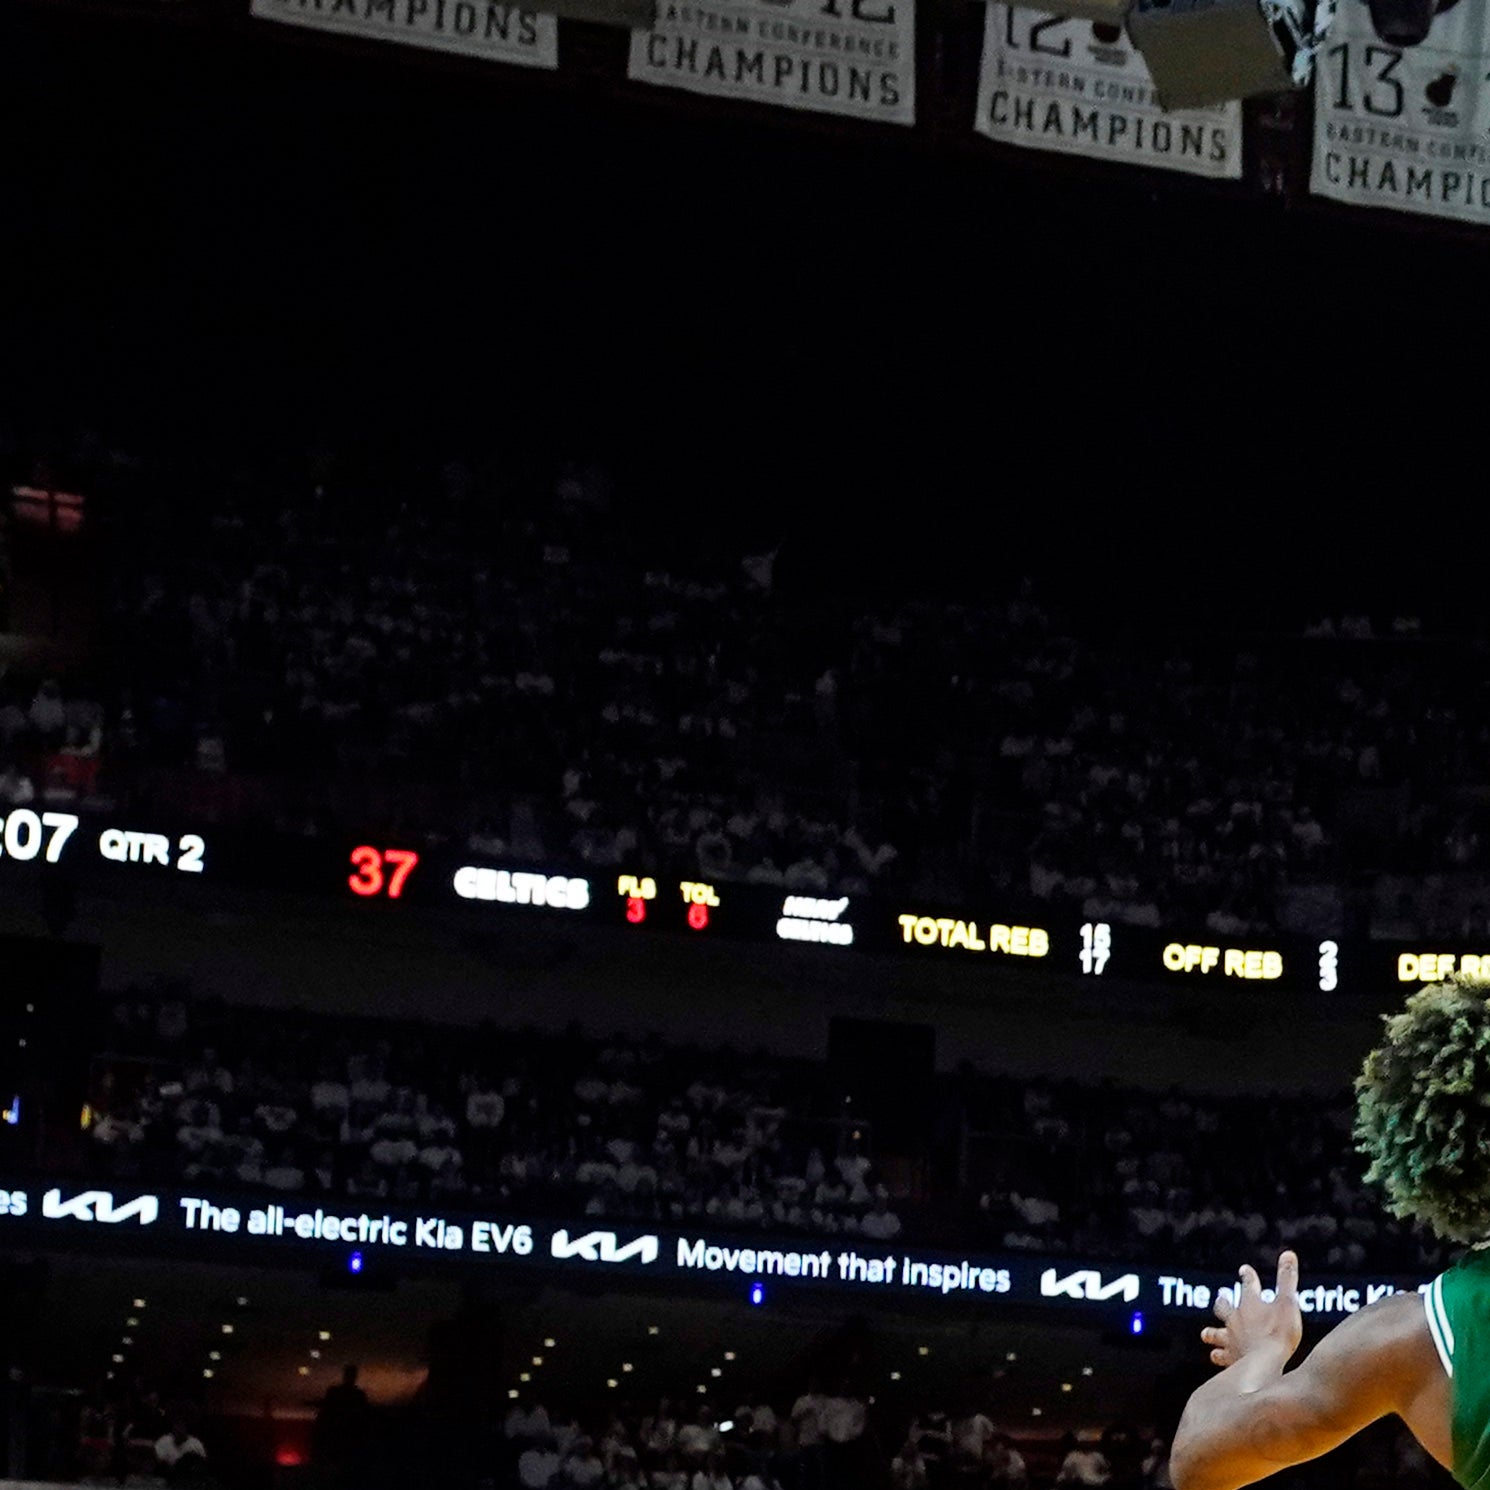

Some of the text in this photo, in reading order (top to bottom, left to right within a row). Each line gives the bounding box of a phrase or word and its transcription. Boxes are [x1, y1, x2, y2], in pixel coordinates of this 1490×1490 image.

[287, 0, 537, 45] MPIONS
[656, 5, 750, 34] ASTERN
[647, 34, 900, 106] CHAMPIONS
[1328, 42, 1404, 118] 13
[989, 90, 1227, 162] CHAMPIONS
[0, 808, 590, 910] 07 QTR 2 37 CELTICS
[898, 913, 1050, 958] TOTAL REB
[1162, 942, 1283, 980] OFF REB
[1397, 952, 1456, 982] DEF
[180, 1196, 241, 1233] The
[247, 1204, 408, 1247] all-electric
[415, 1216, 464, 1250] Kia
[471, 1220, 533, 1256] EV6
[677, 1236, 832, 1279] Movement
[837, 1251, 897, 1283] that
[901, 1256, 1011, 1295] inspires
[1158, 1275, 1211, 1309] The
